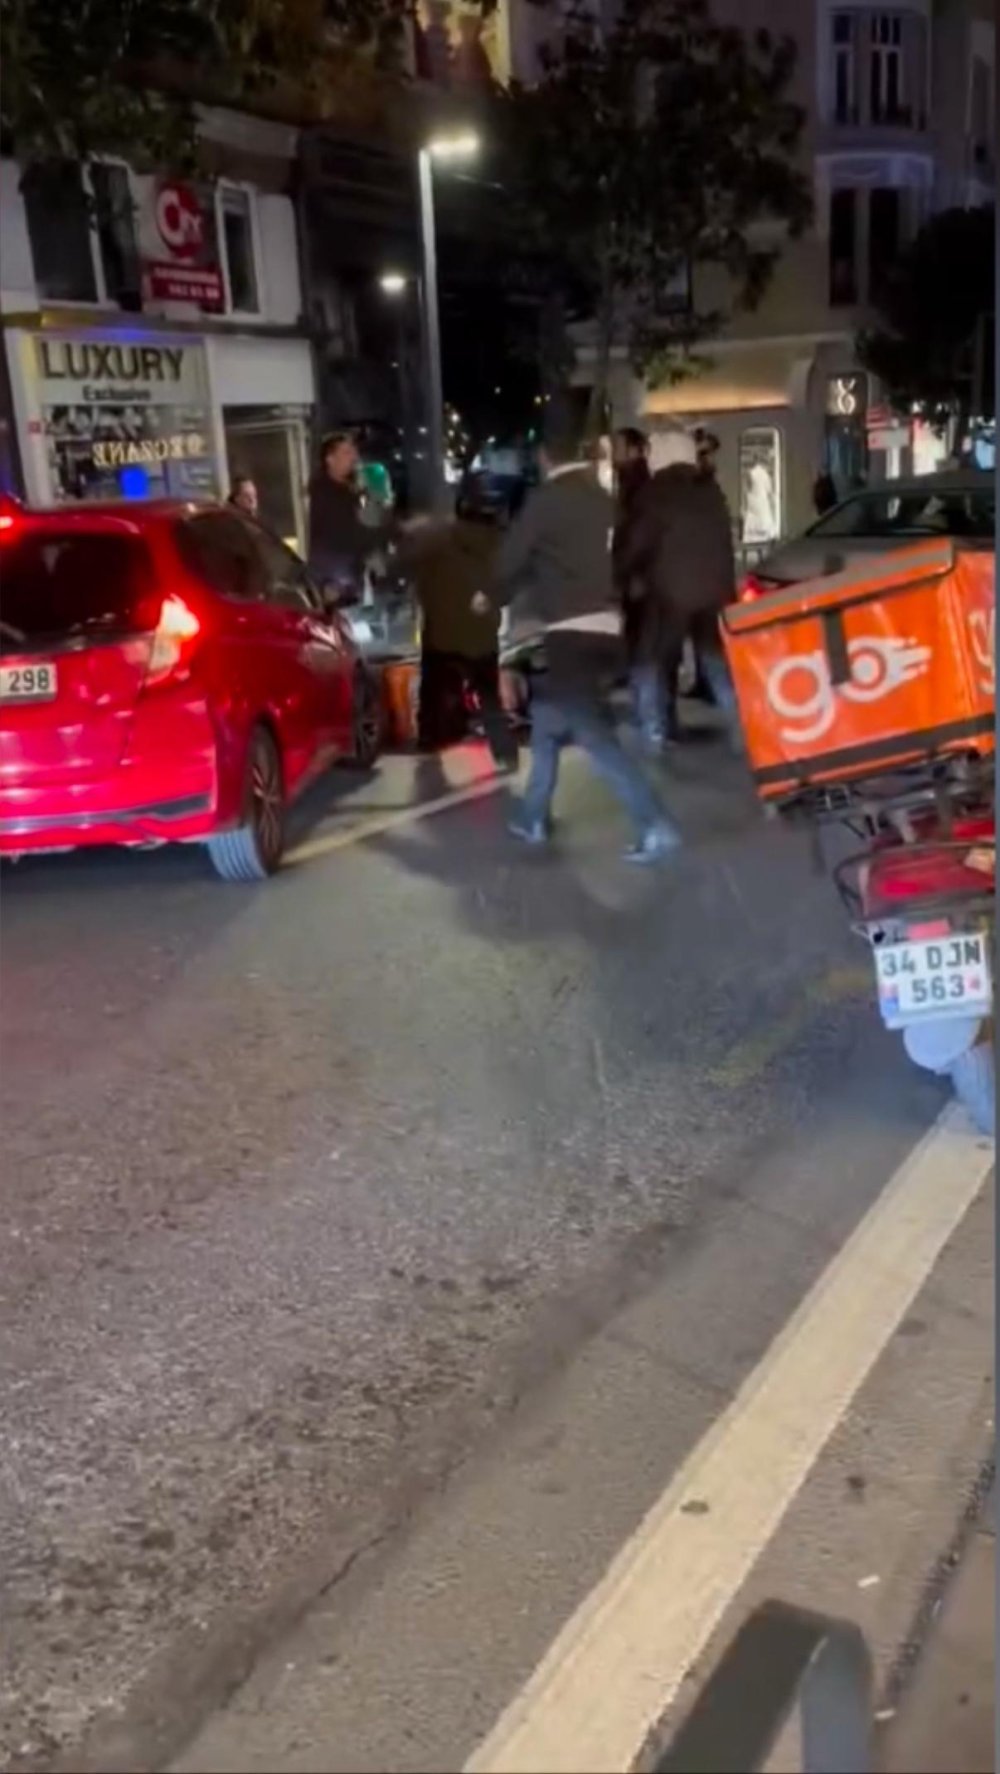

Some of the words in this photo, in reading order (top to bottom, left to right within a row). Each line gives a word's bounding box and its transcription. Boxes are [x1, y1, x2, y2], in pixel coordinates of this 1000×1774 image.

[41, 342, 184, 382] LUXURY
[8, 667, 49, 692] 298
[880, 949, 916, 976] 34
[926, 939, 981, 971] DJN
[911, 974, 965, 1004] 563
